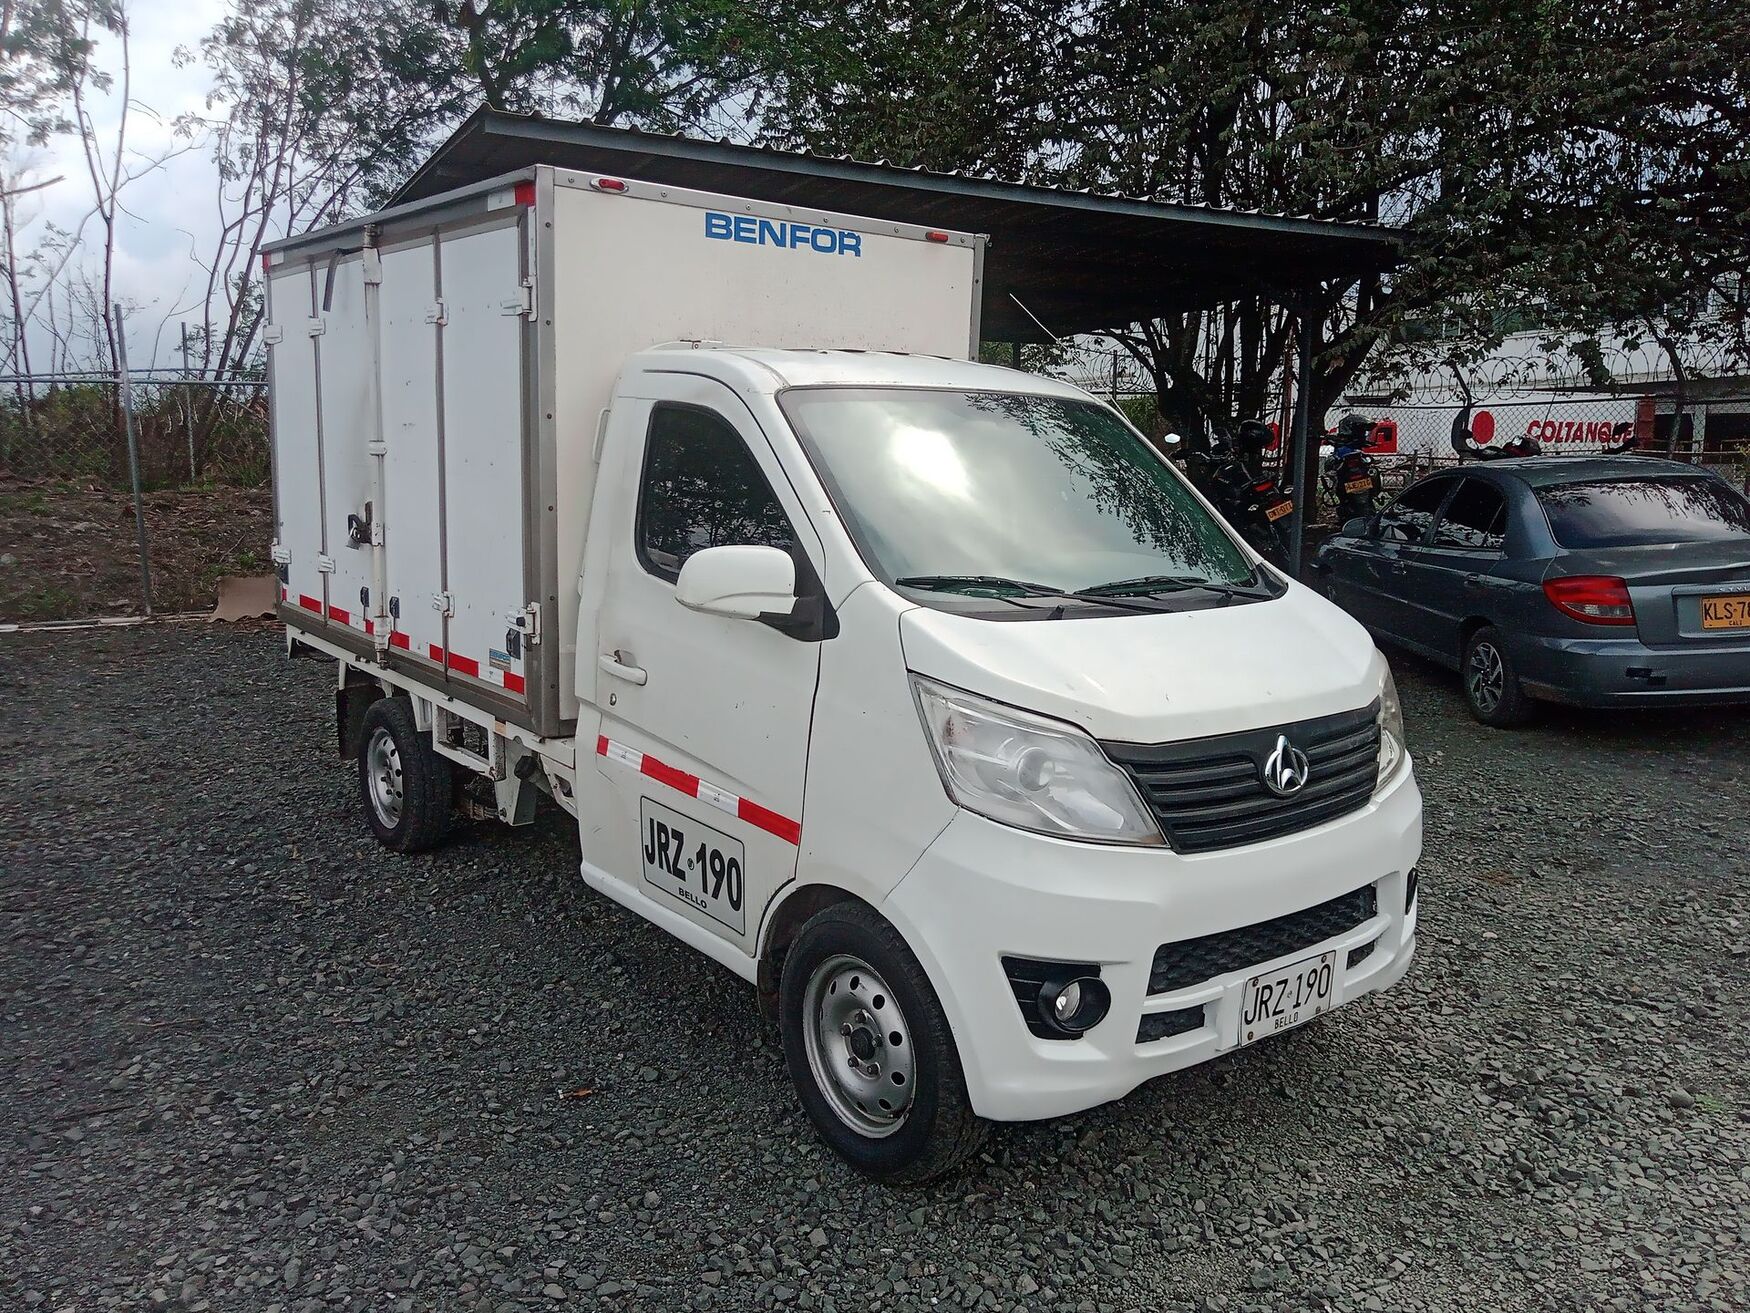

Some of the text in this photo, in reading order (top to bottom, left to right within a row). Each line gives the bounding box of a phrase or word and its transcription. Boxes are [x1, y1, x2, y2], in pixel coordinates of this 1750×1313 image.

[705, 212, 862, 257] BENFOR
[678, 887, 707, 909] BELLO
[1274, 1012, 1299, 1029] BELLO
